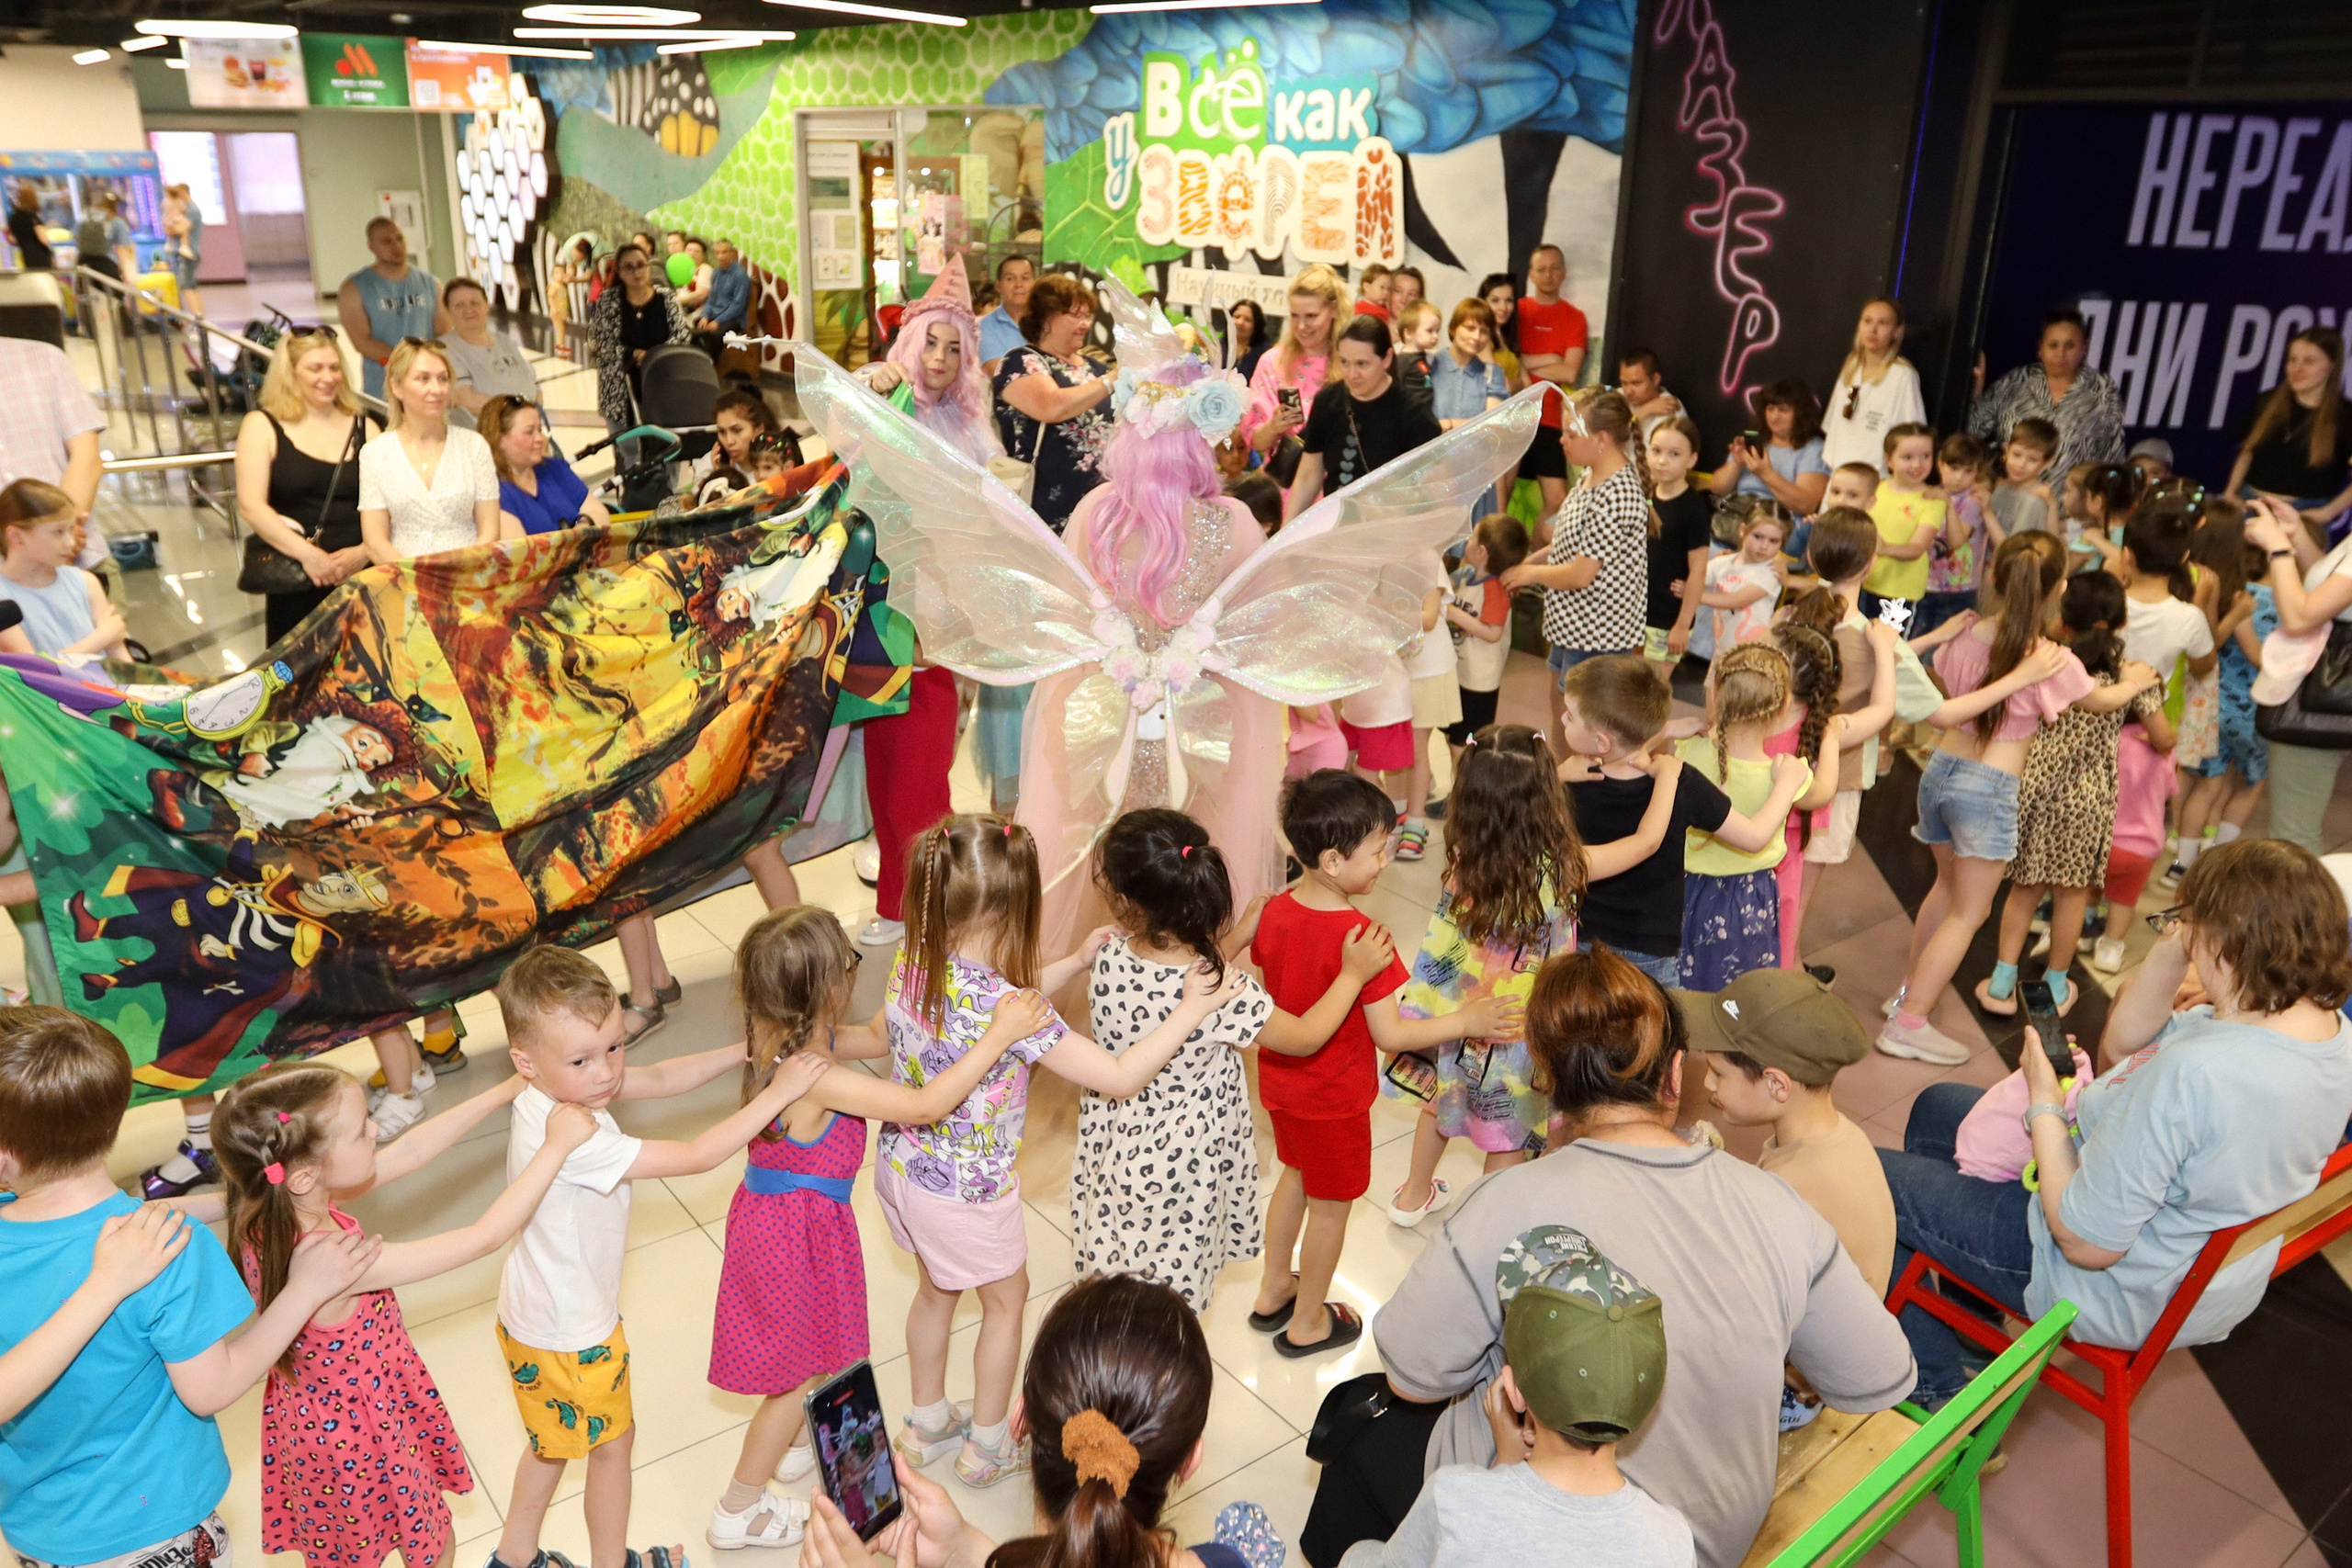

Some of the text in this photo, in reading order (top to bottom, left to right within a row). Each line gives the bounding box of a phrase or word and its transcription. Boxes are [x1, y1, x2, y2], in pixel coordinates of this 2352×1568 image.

[1274, 86, 1373, 141] как
[2126, 111, 2352, 254] НЕРЕА
[2207, 304, 2352, 430] РО
